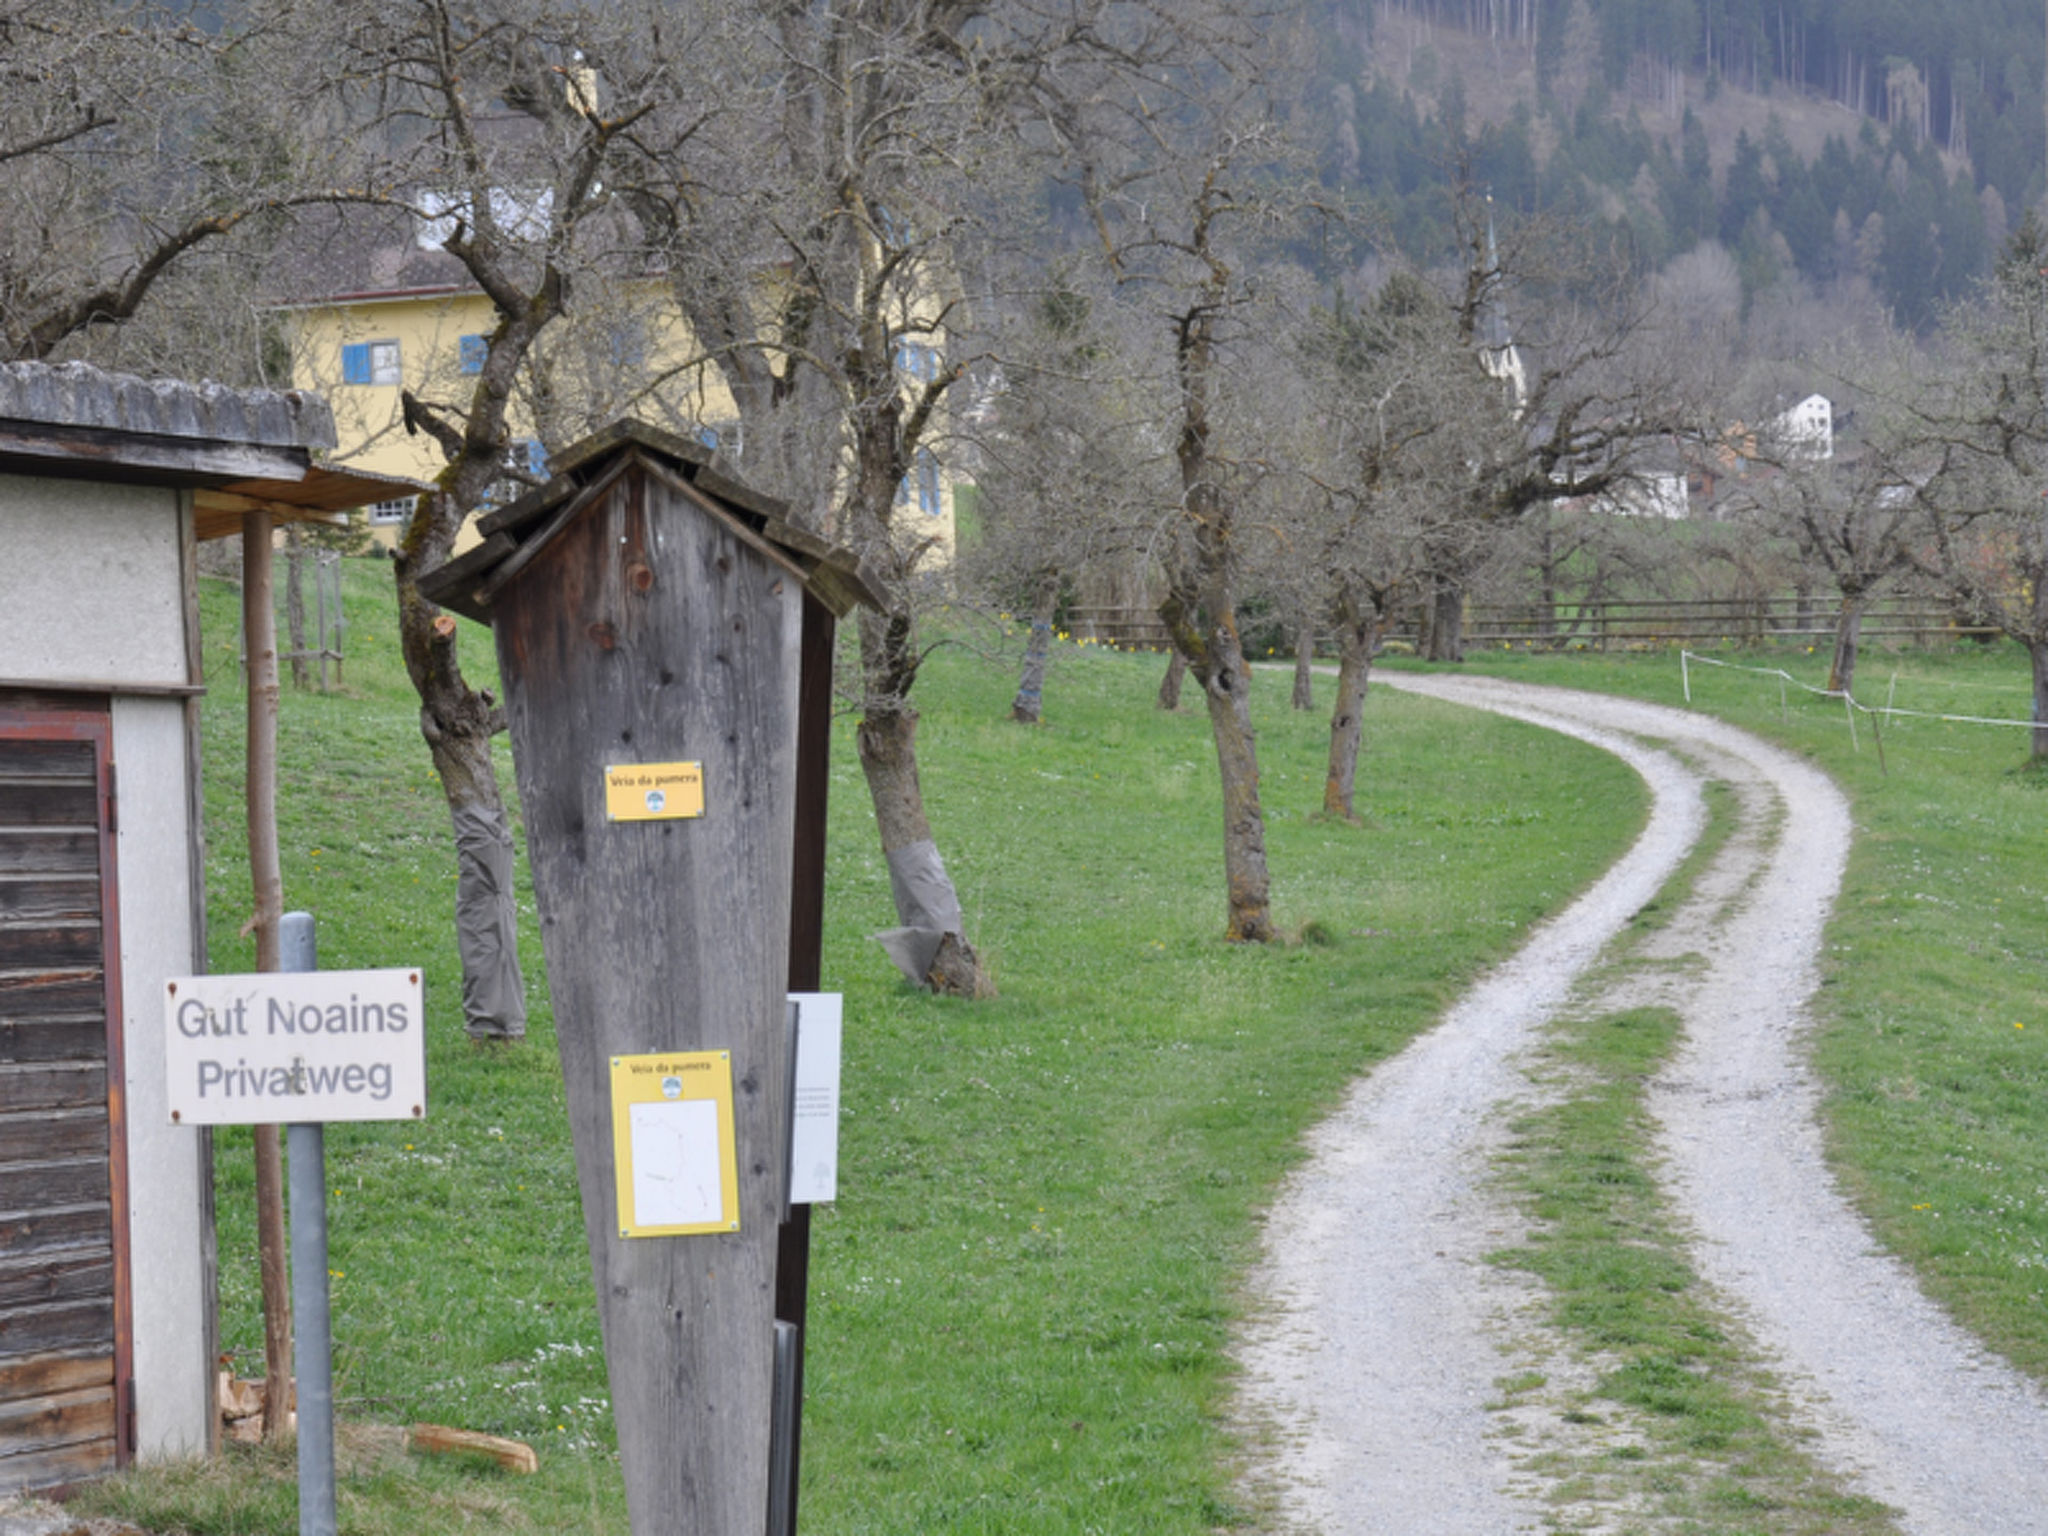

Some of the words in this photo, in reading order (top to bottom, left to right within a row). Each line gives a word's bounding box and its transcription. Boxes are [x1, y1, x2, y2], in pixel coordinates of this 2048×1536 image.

[638, 775, 652, 785] da
[177, 997, 248, 1038] Gut
[267, 994, 409, 1035] Noains
[197, 1056, 393, 1101] Privatweg
[655, 1062, 669, 1073] da
